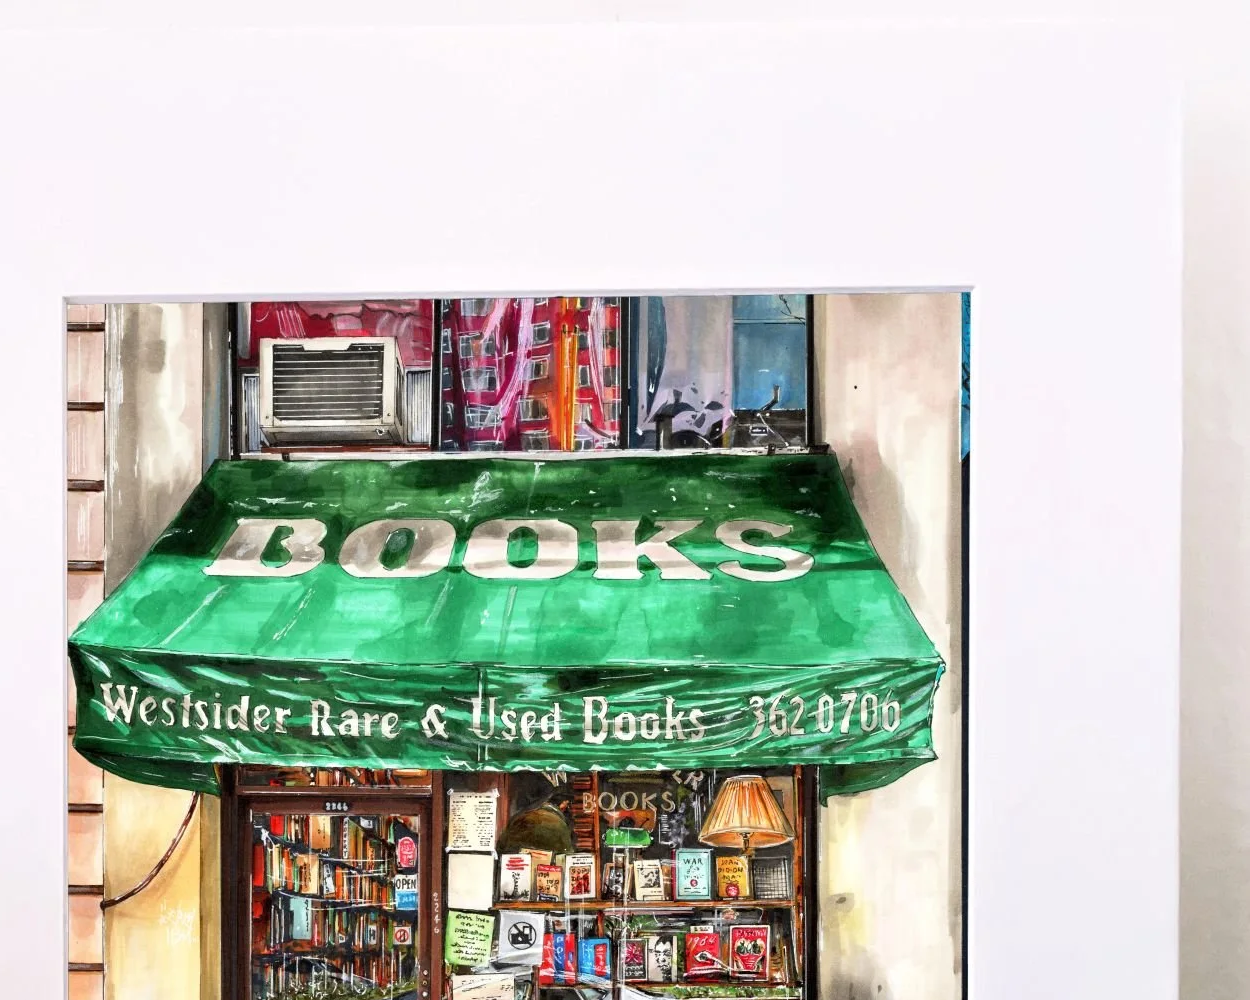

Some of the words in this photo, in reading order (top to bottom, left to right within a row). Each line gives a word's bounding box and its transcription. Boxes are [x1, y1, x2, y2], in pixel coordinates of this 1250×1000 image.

[202, 517, 816, 583] BOOKS
[100, 682, 292, 735] Westsider
[309, 698, 402, 739] Rare
[420, 703, 450, 739] &
[469, 696, 563, 743] Used
[581, 695, 707, 745] Books
[582, 790, 676, 814] BOOKS
[395, 878, 417, 890] OPEN
[688, 935, 716, 952] 1984
